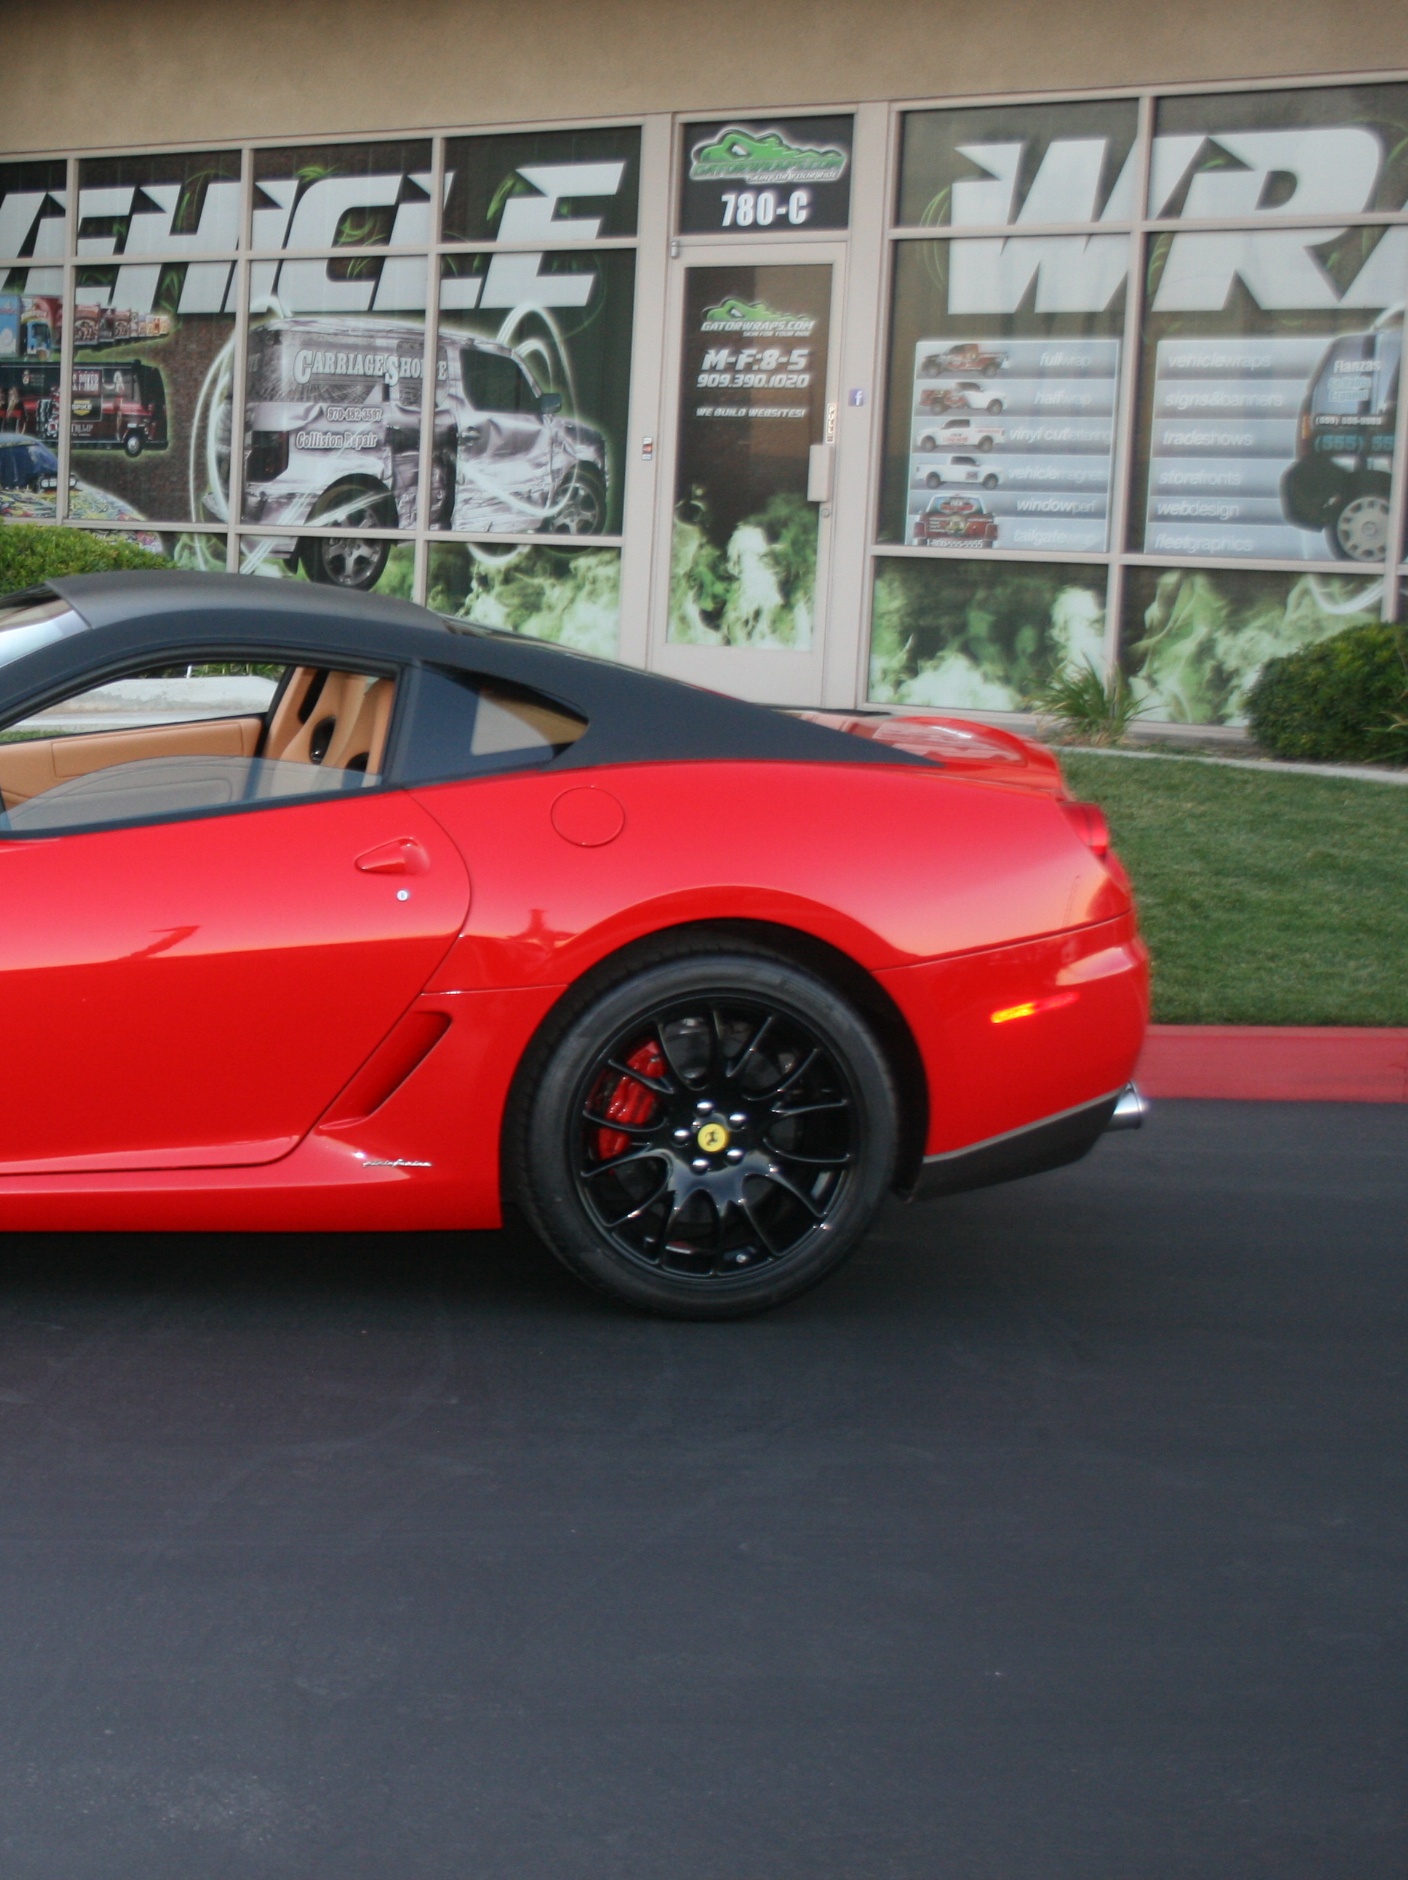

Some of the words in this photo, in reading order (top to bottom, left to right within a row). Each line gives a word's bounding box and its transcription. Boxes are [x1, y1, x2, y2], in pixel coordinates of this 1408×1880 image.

[721, 191, 807, 226] 780-C
[700, 320, 815, 331] GATORWRAPS.COM
[385, 354, 447, 386] SHOE
[696, 374, 809, 388] 909.390.1020
[696, 408, 713, 417] WE
[714, 408, 746, 417] BUILD
[748, 408, 805, 418] WEBSITES!
[296, 431, 342, 450] Collision
[342, 432, 378, 451] Repair
[1009, 427, 1043, 443] vinyl
[1162, 430, 1253, 446] tradeshows
